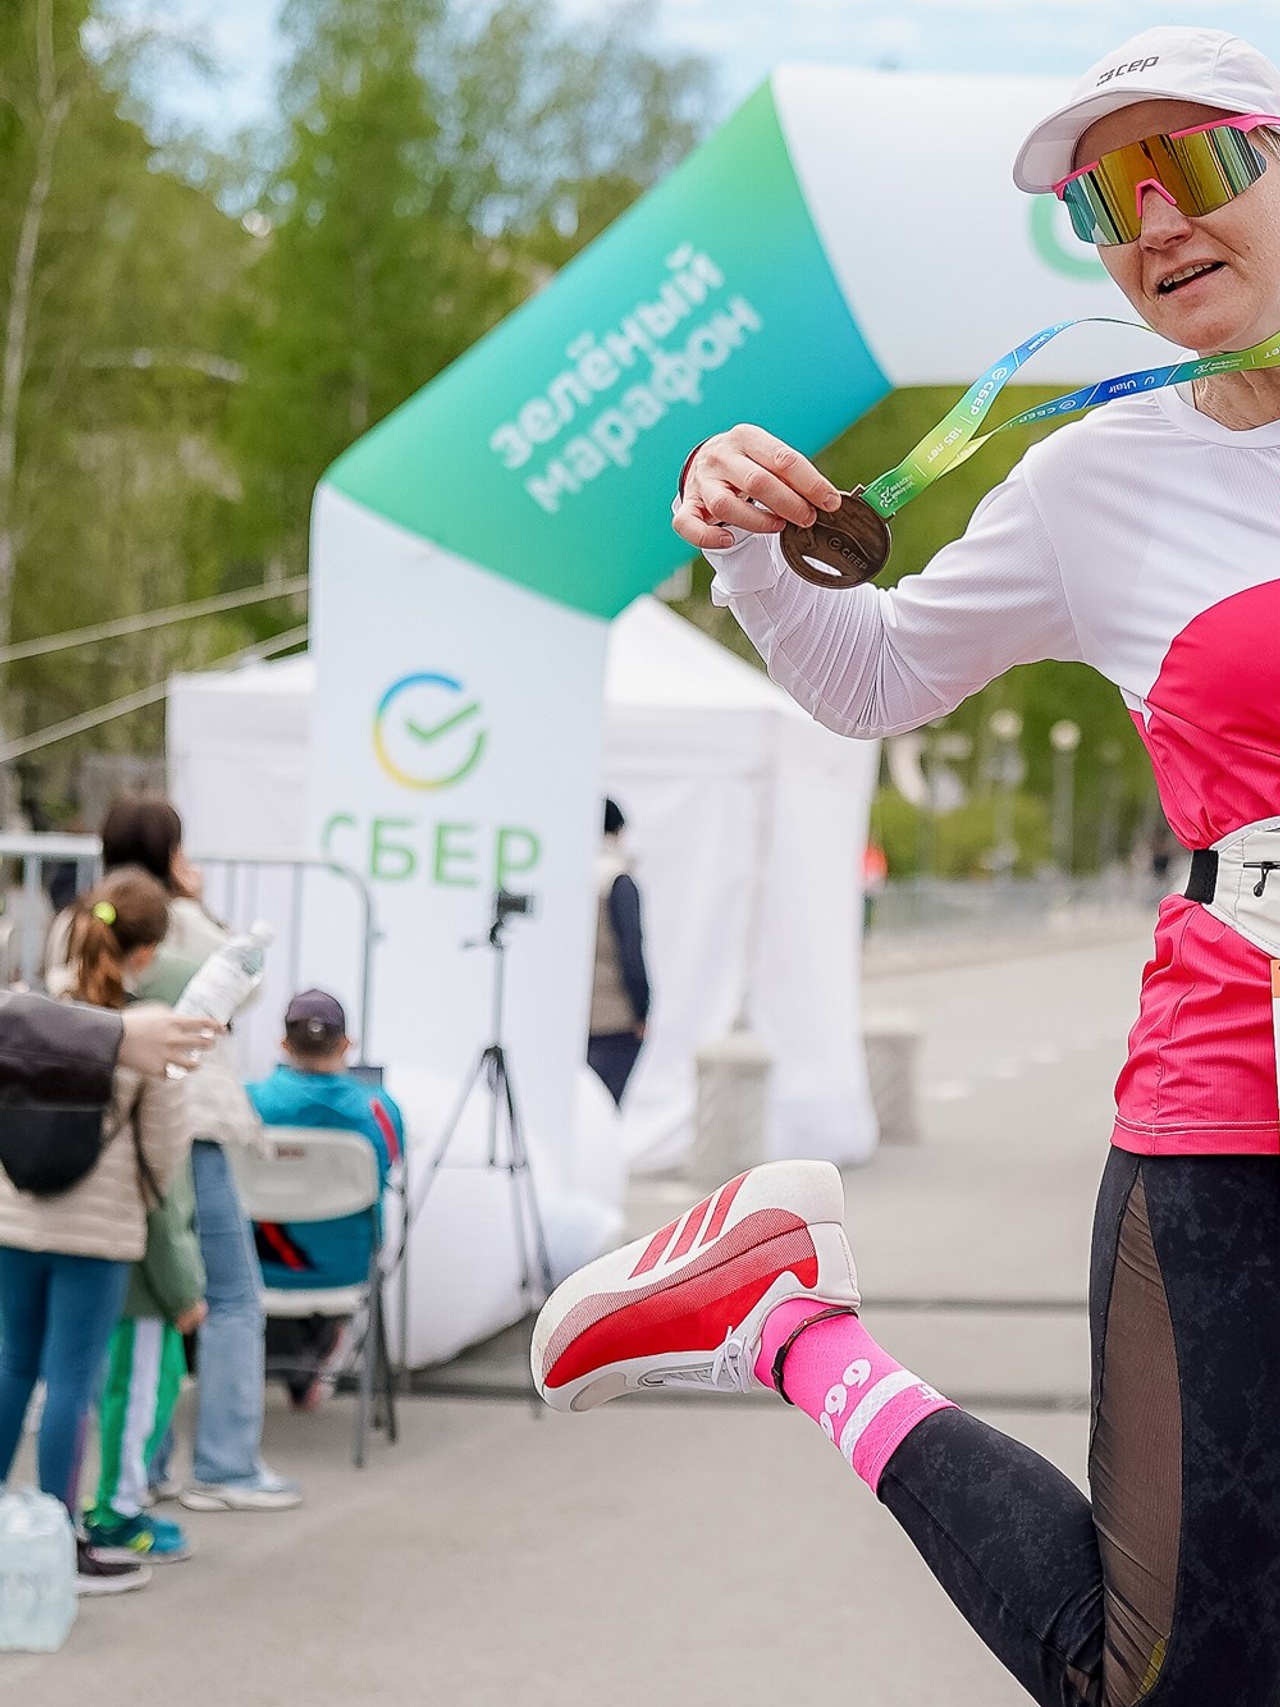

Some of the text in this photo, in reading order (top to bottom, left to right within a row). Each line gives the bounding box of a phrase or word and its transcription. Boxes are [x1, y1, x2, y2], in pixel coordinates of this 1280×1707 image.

[490, 243, 724, 469] зелёный
[525, 297, 762, 513] марафон
[970, 380, 995, 416] СБЕР
[1108, 378, 1137, 395] Utair
[926, 425, 964, 464] 185 лет
[320, 811, 544, 892] СБЕР
